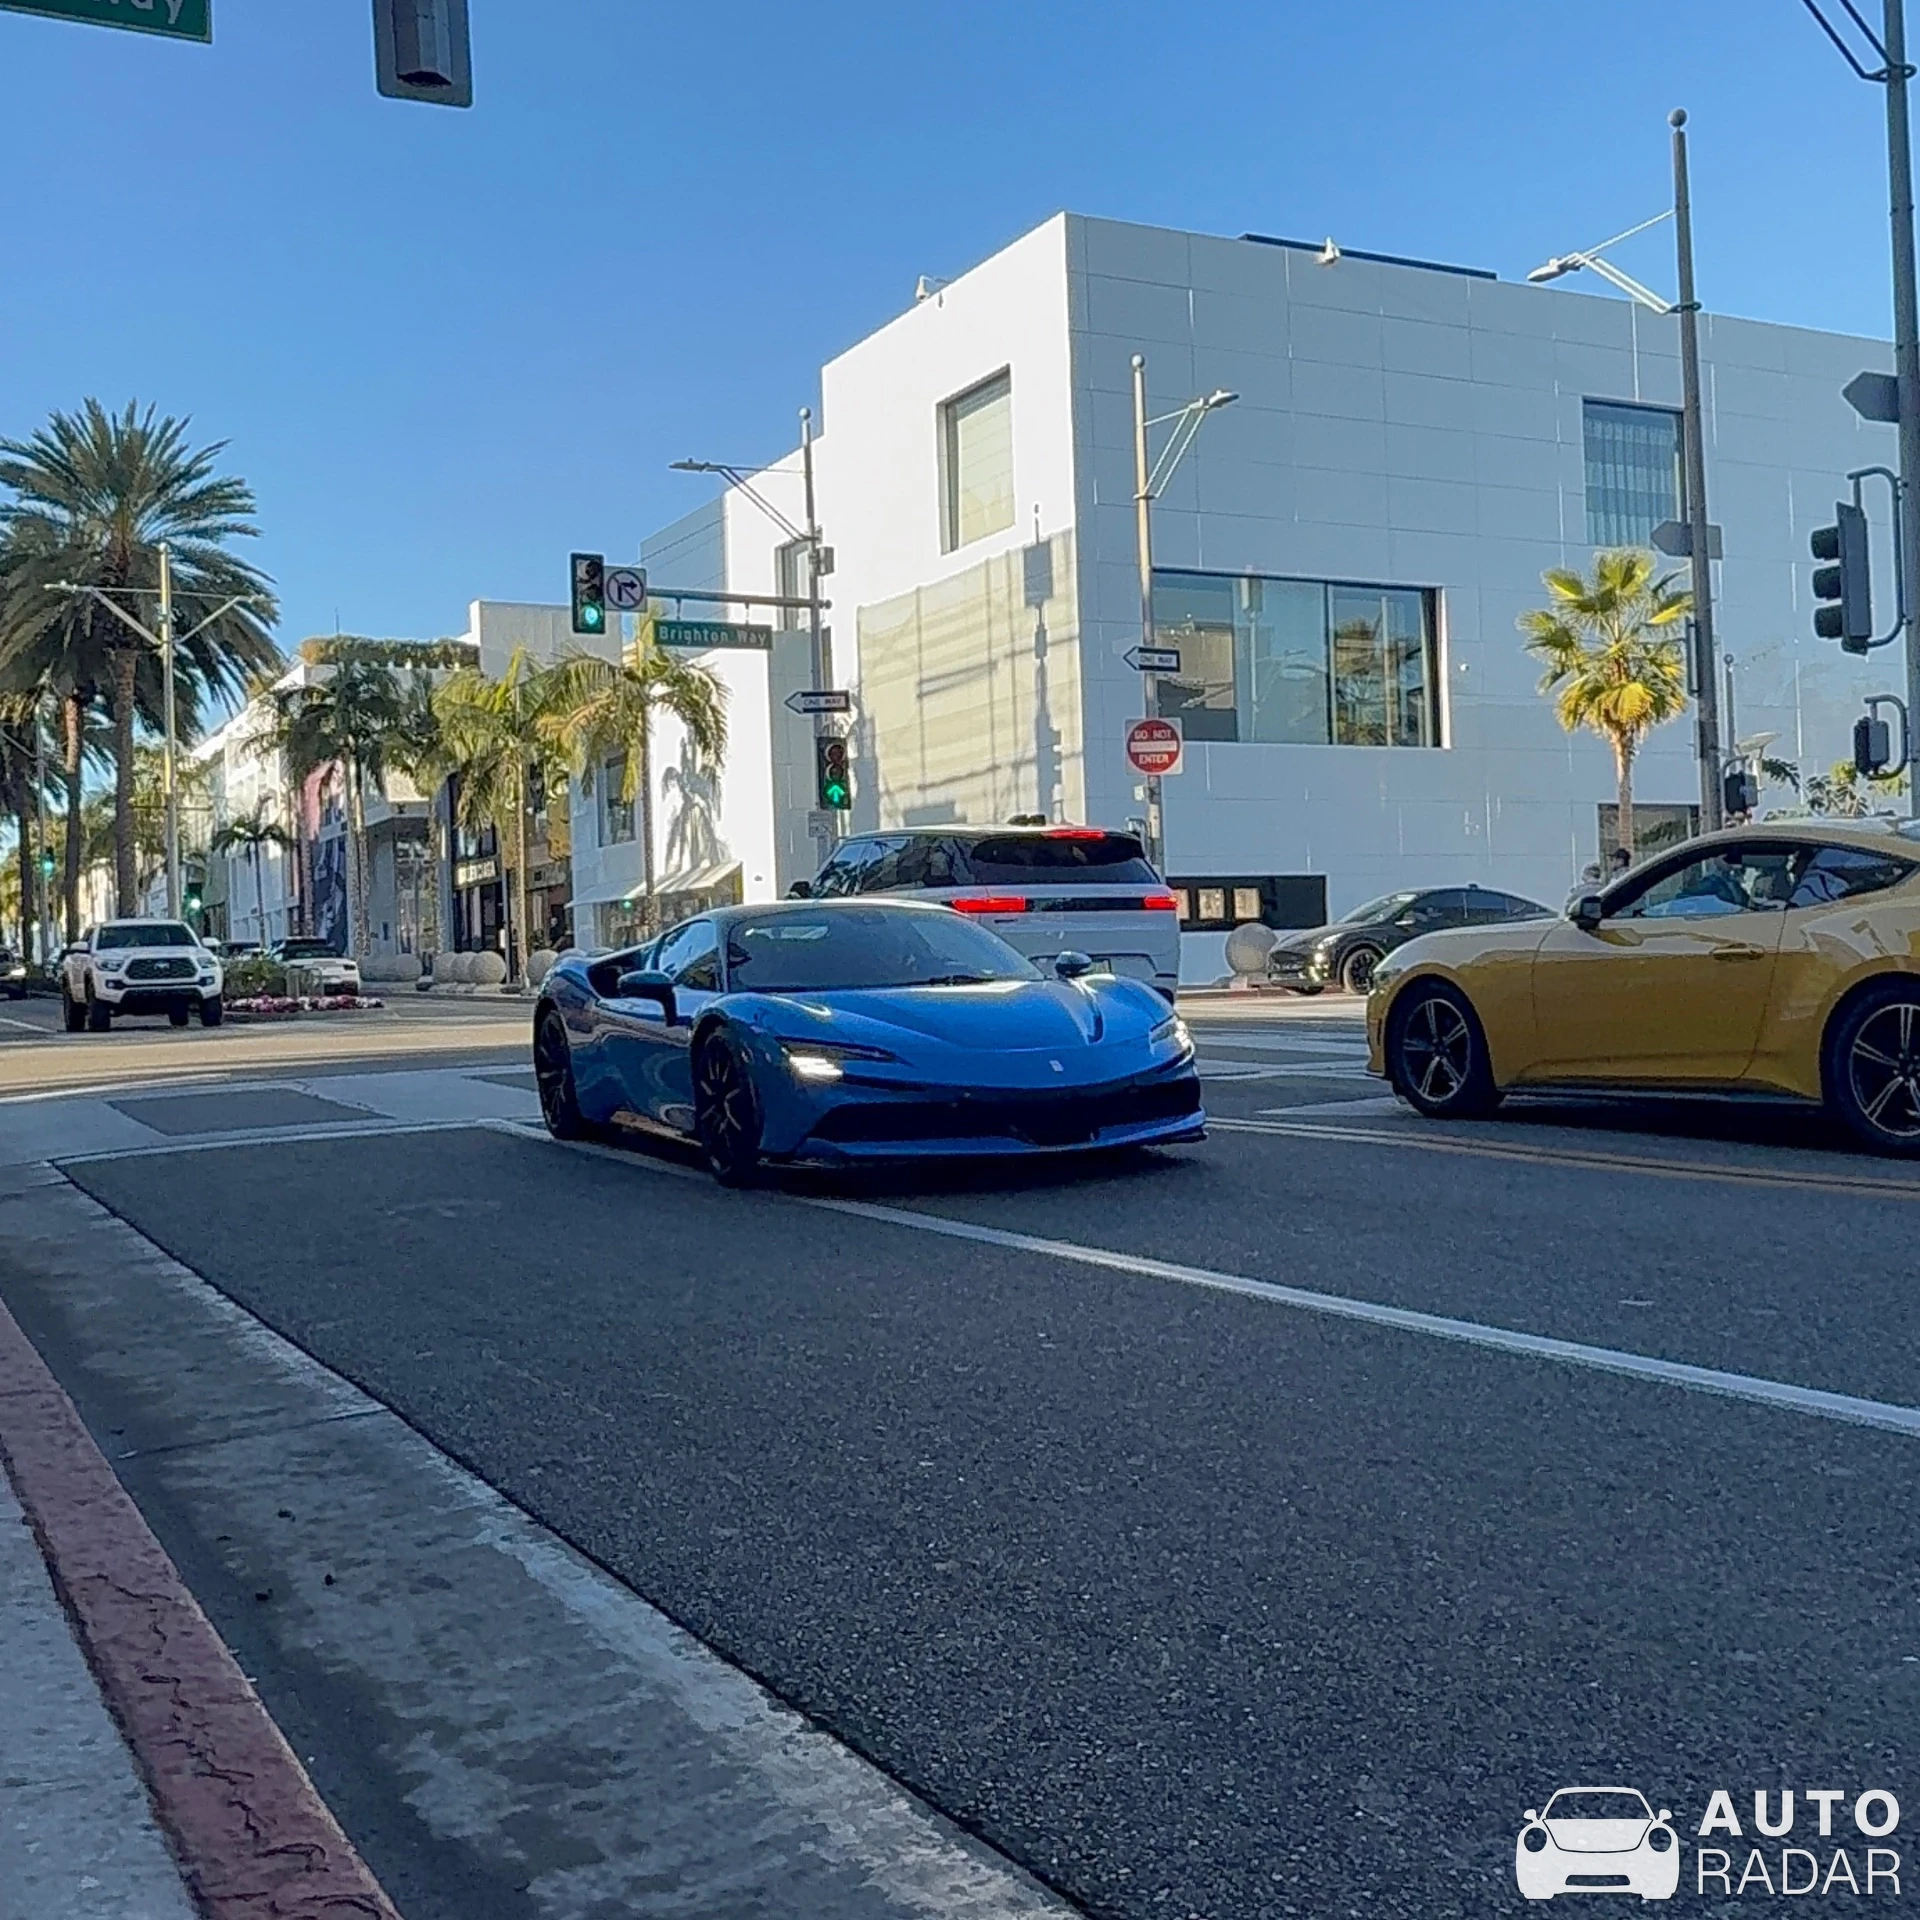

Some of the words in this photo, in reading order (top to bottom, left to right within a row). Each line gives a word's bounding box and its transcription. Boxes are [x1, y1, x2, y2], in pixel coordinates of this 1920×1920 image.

[659, 625, 729, 645] Brighton
[736, 628, 767, 647] Way
[1134, 729, 1149, 740] DO
[1152, 729, 1172, 740] NOT
[1138, 753, 1169, 765] ENTER
